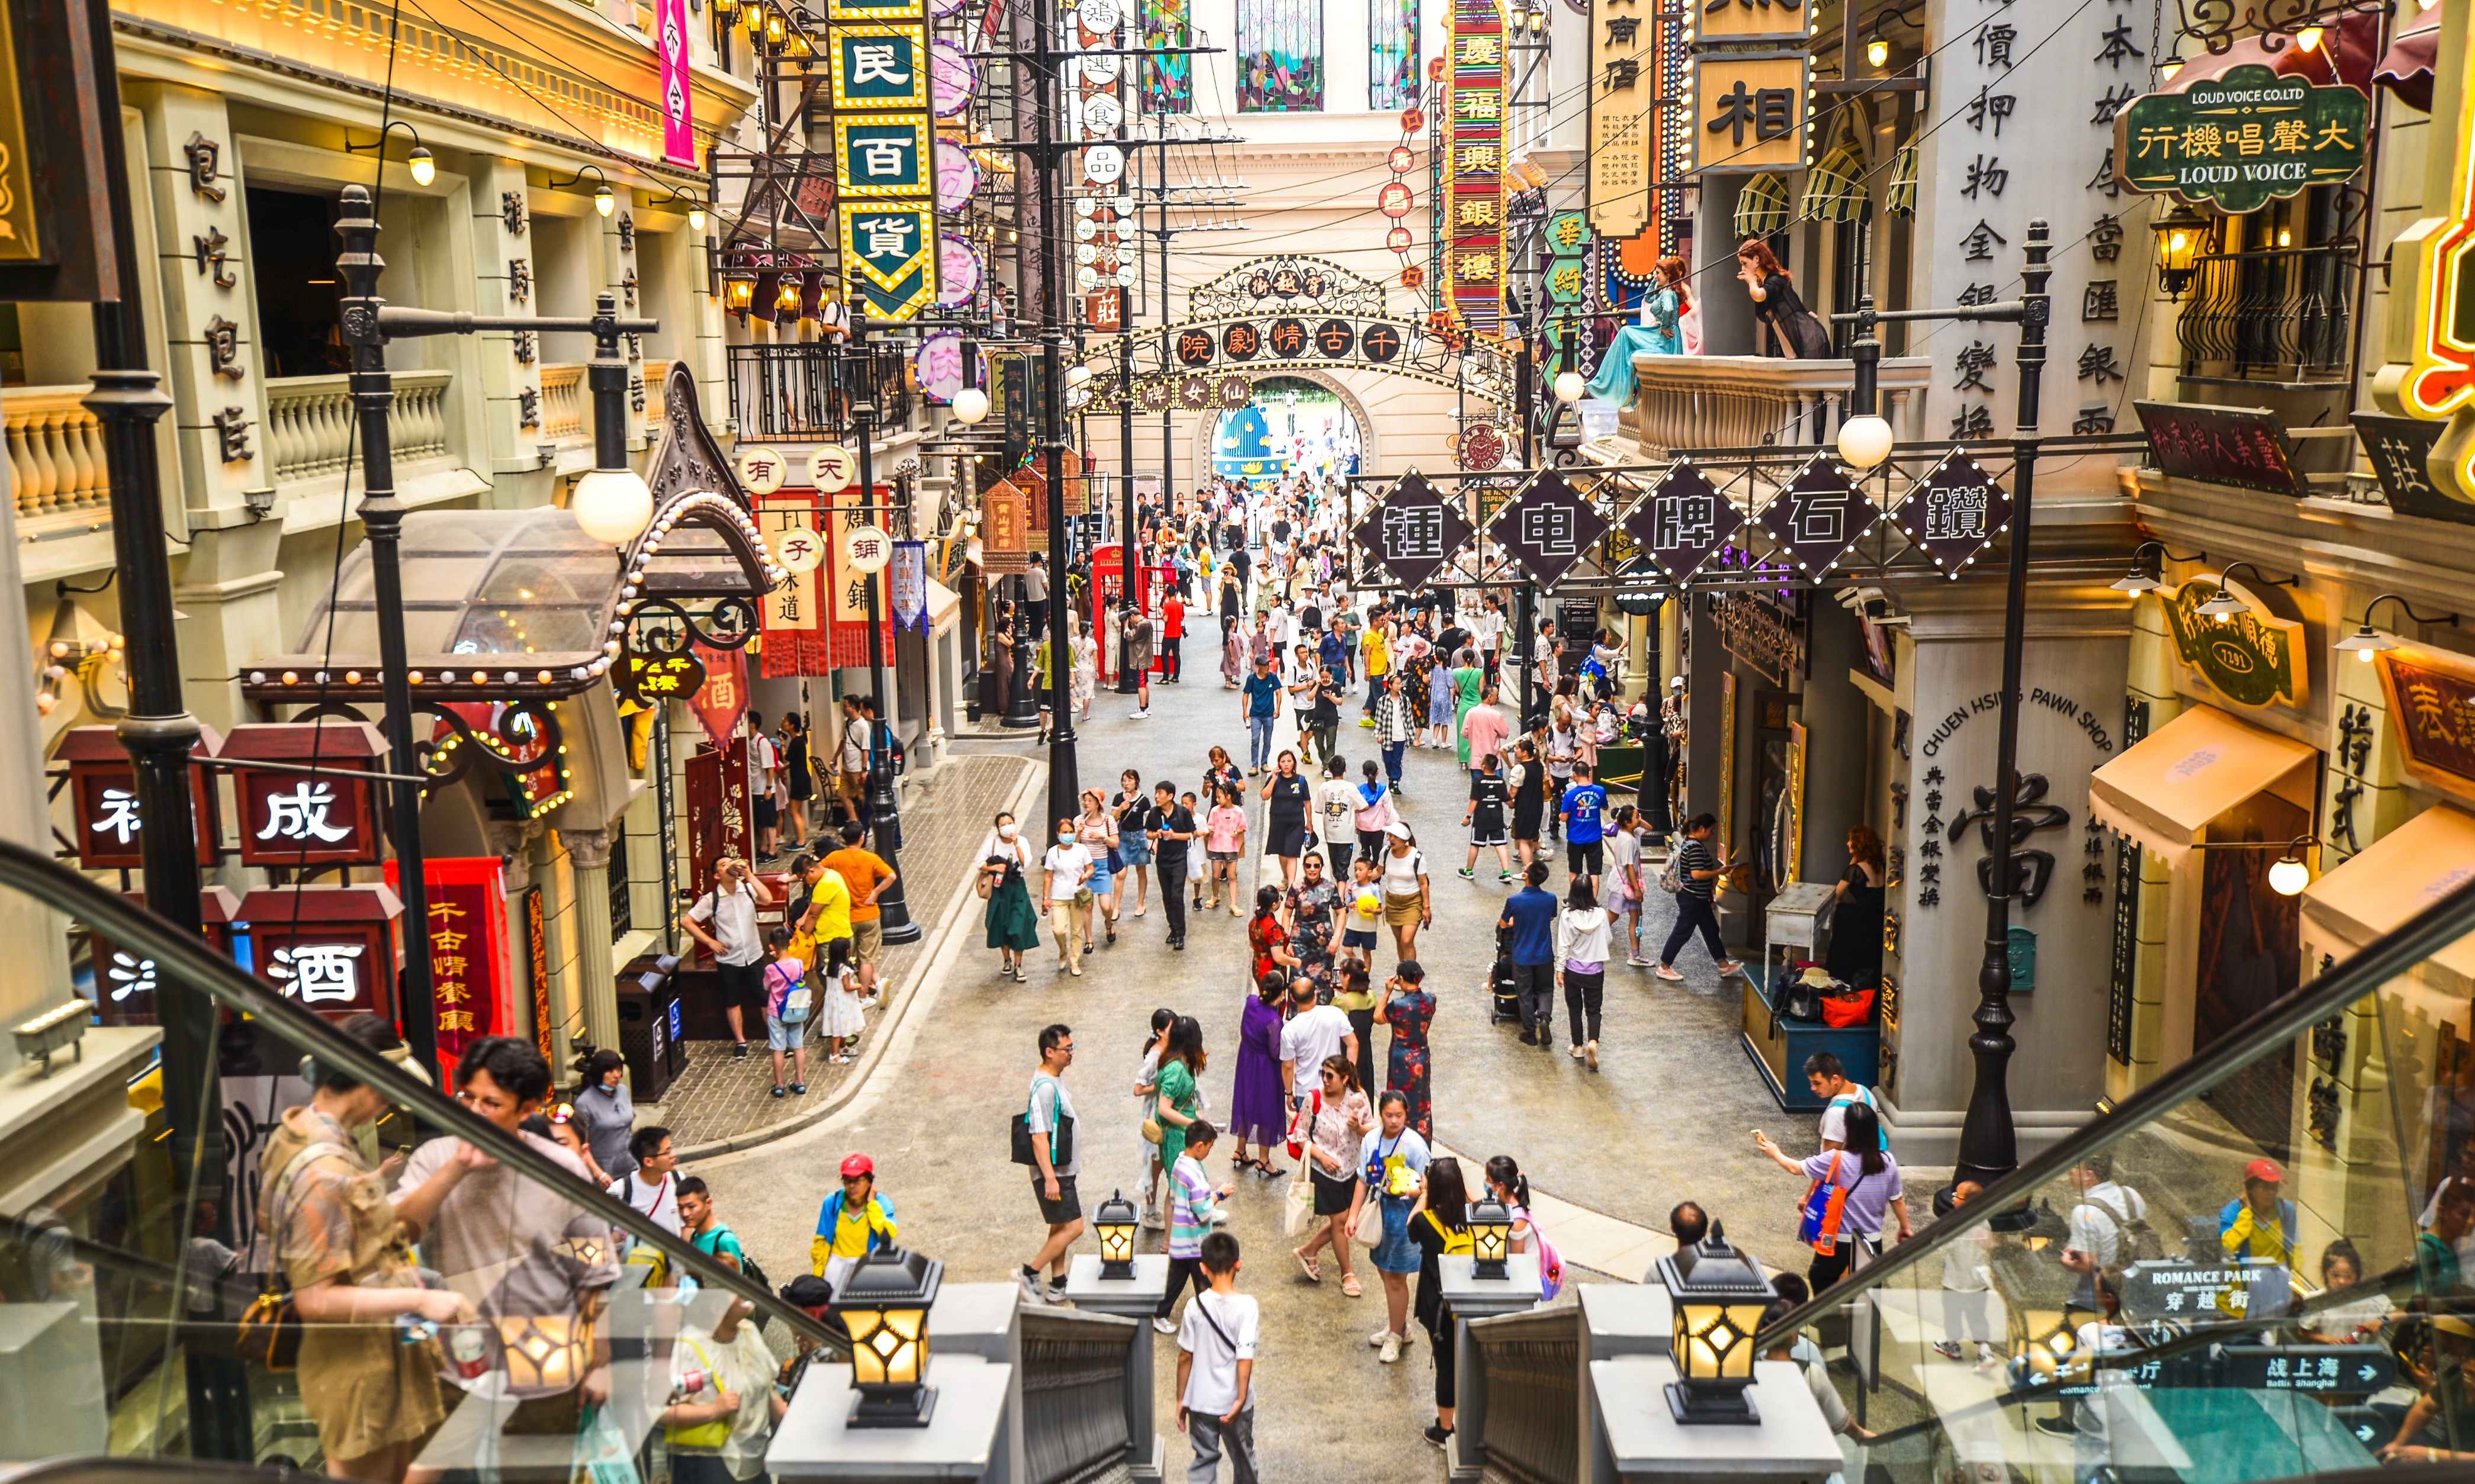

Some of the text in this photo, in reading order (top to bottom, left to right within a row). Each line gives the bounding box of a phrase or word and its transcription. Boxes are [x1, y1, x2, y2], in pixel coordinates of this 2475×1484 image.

[1602, 0, 1641, 88] 商店
[2192, 88, 2304, 105] LOUD VOICE CO.LTD
[2138, 120, 2355, 160] 大聲唱機行
[852, 45, 914, 259] 民百貨
[2180, 162, 2307, 185] LOUD VOICE
[2221, 649, 2246, 668] 7291
[701, 672, 735, 710] 酒
[1923, 707, 1969, 757] CHUEN
[1971, 687, 2023, 714] HSI
[2031, 688, 2078, 717] PAWN
[2077, 711, 2113, 752] SHOP
[2152, 1269, 2261, 1285] ROMANCE PARK
[2267, 1357, 2339, 1377] 战上海
[2295, 1379, 2336, 1390] Shanghai
